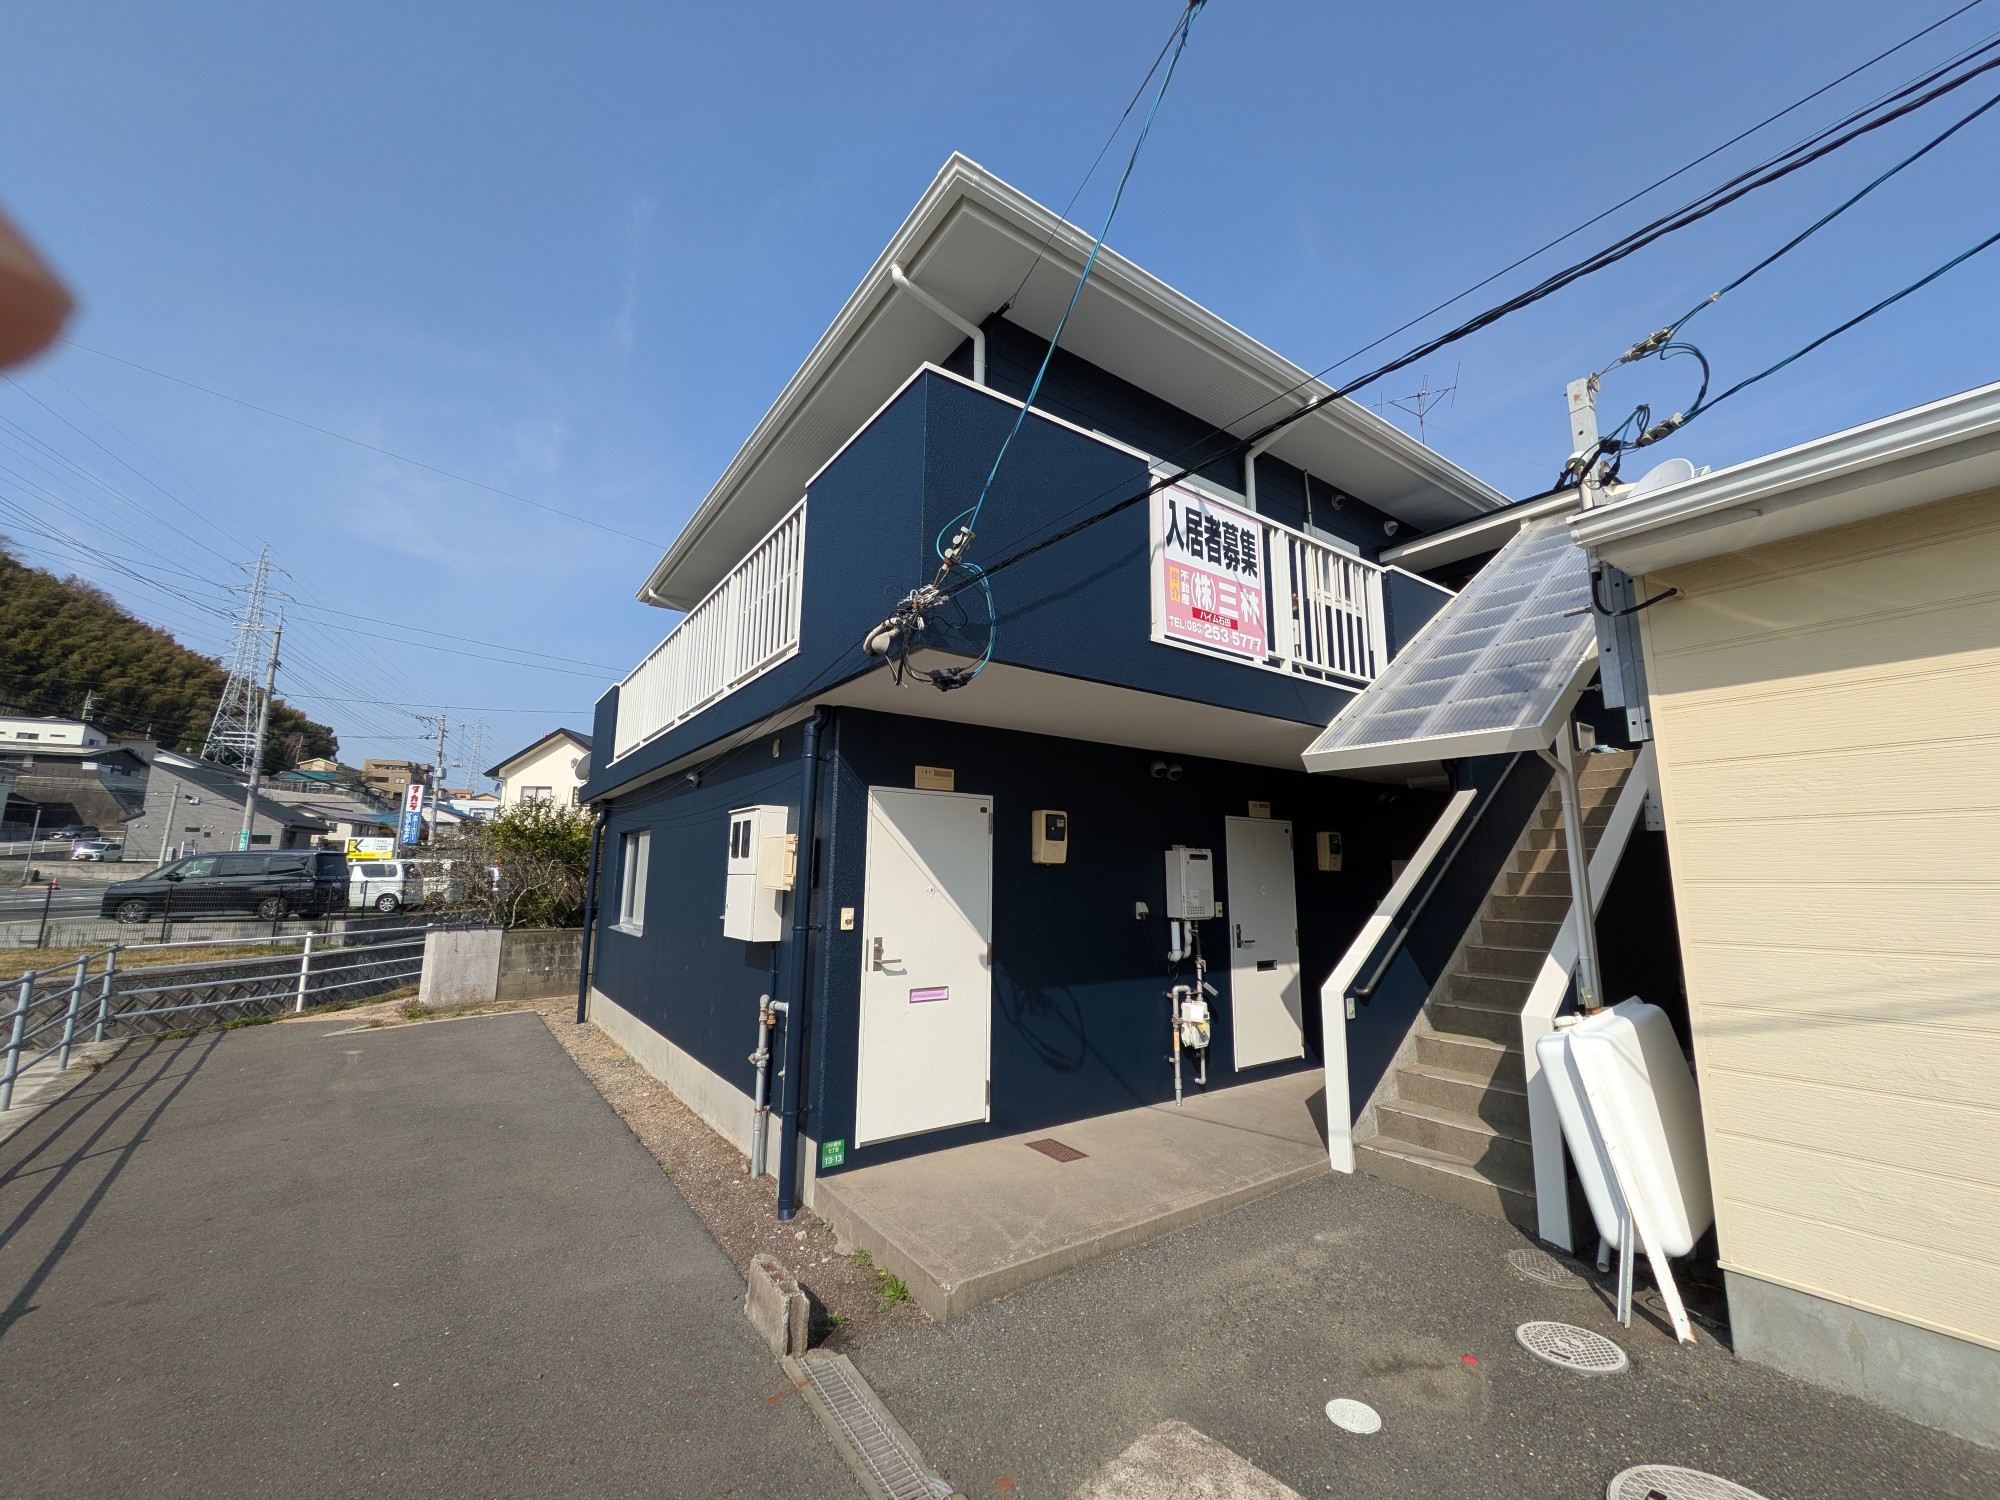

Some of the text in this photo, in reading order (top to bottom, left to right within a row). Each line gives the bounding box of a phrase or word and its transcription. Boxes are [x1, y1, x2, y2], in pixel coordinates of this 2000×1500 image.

[1166, 499, 1258, 579] 入居者募集
[1181, 569, 1190, 606] 不動産
[1200, 611, 1231, 627] ハイム石田
[410, 786, 420, 810] タカラ
[825, 1155, 842, 1164] 13-13
